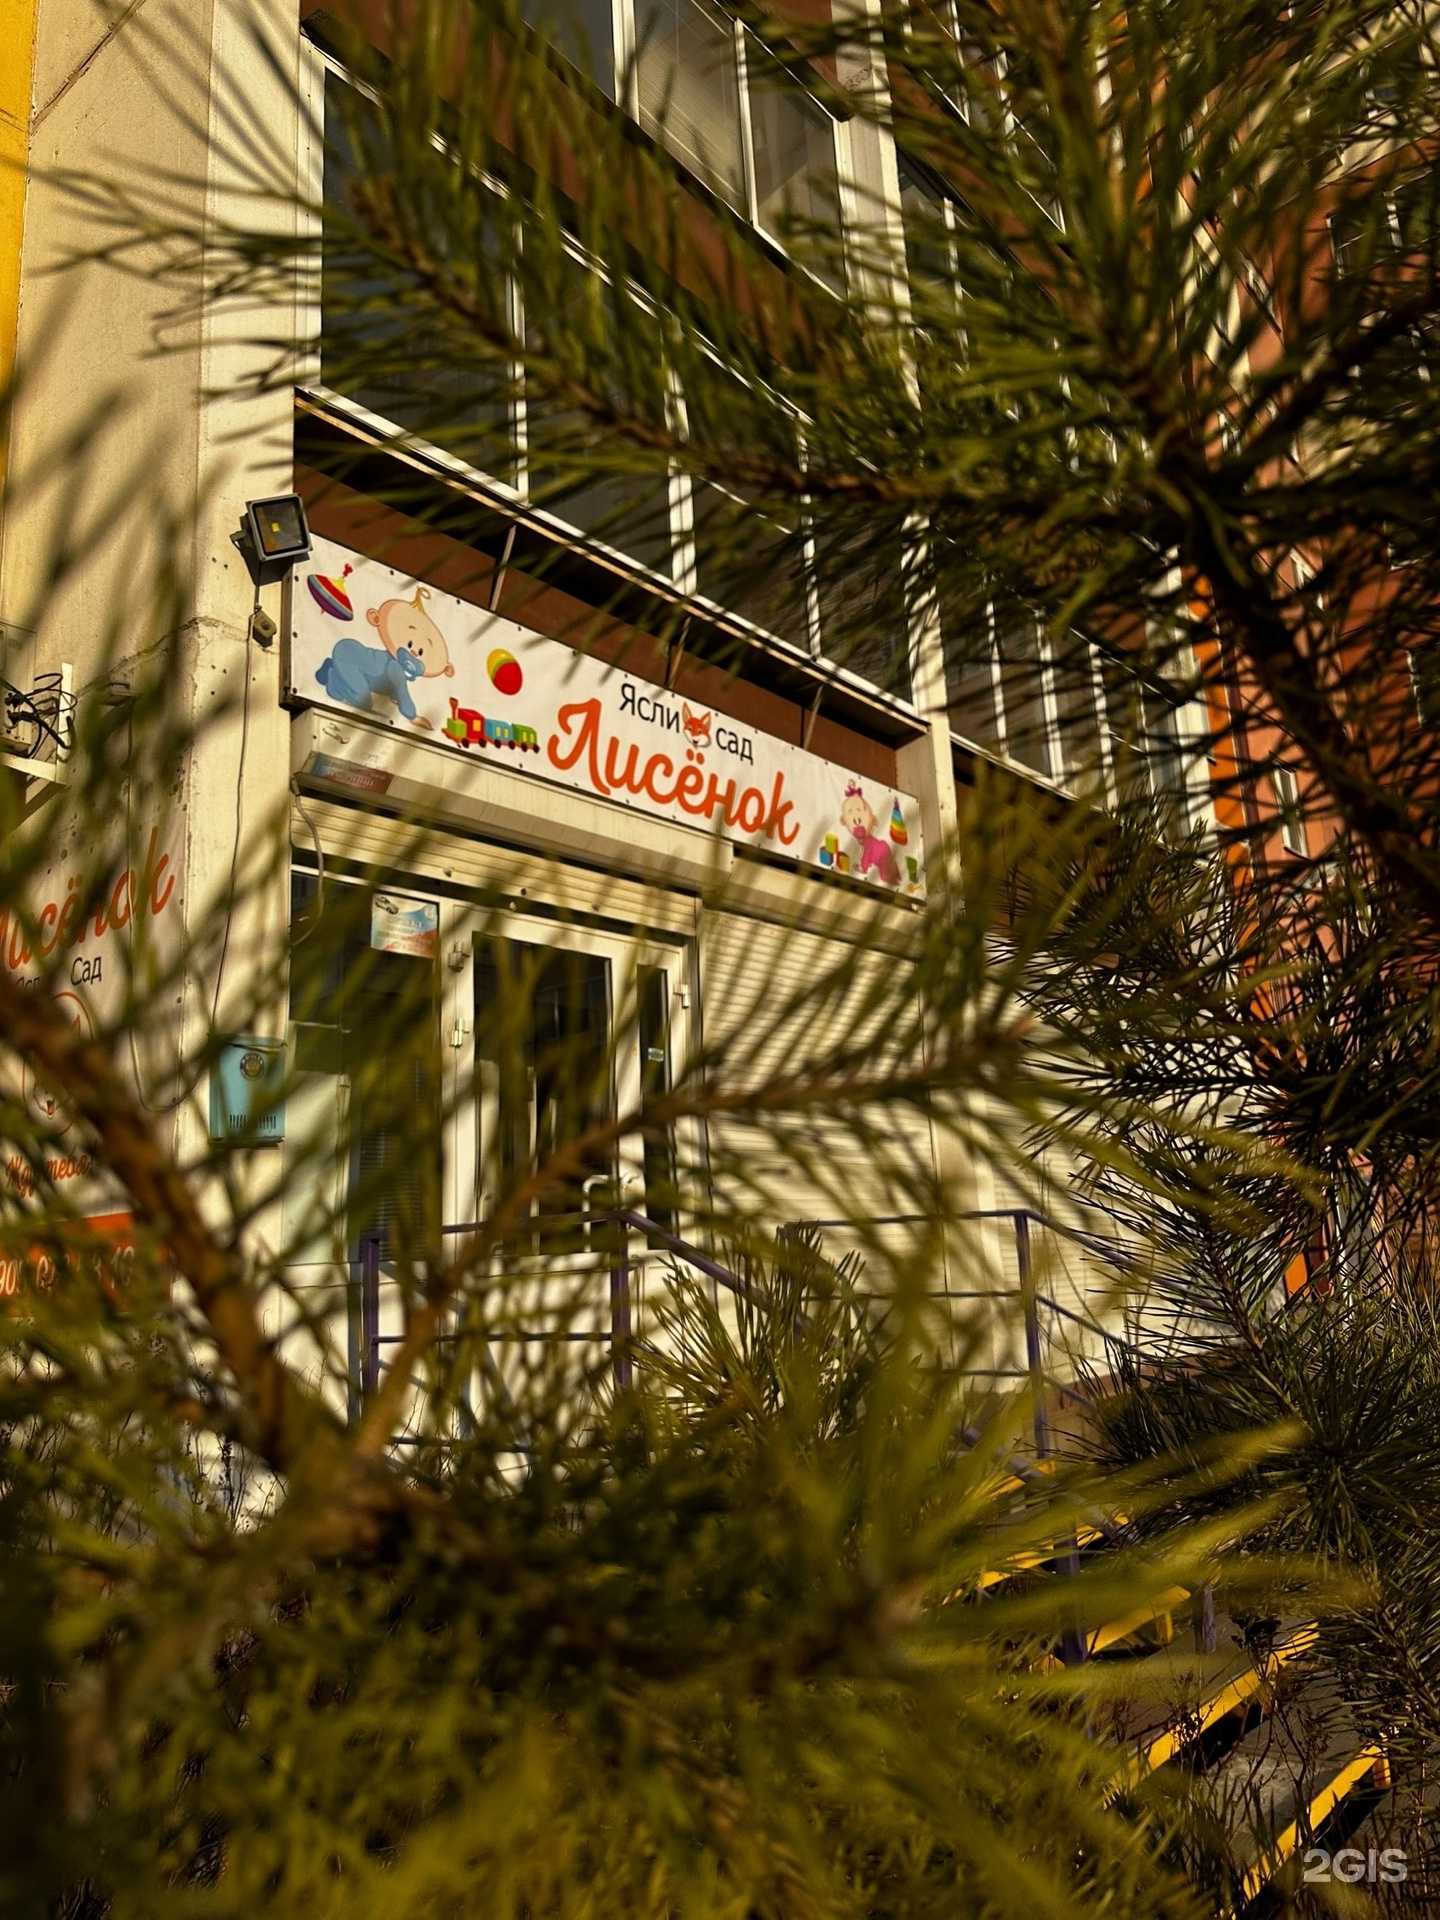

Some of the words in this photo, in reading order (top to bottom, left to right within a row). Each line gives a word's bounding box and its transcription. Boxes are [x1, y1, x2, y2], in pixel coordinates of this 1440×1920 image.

[619, 683, 680, 733] Ясли
[715, 727, 754, 766] сад
[547, 697, 800, 846] Лисёнок
[70, 956, 103, 987] Сад
